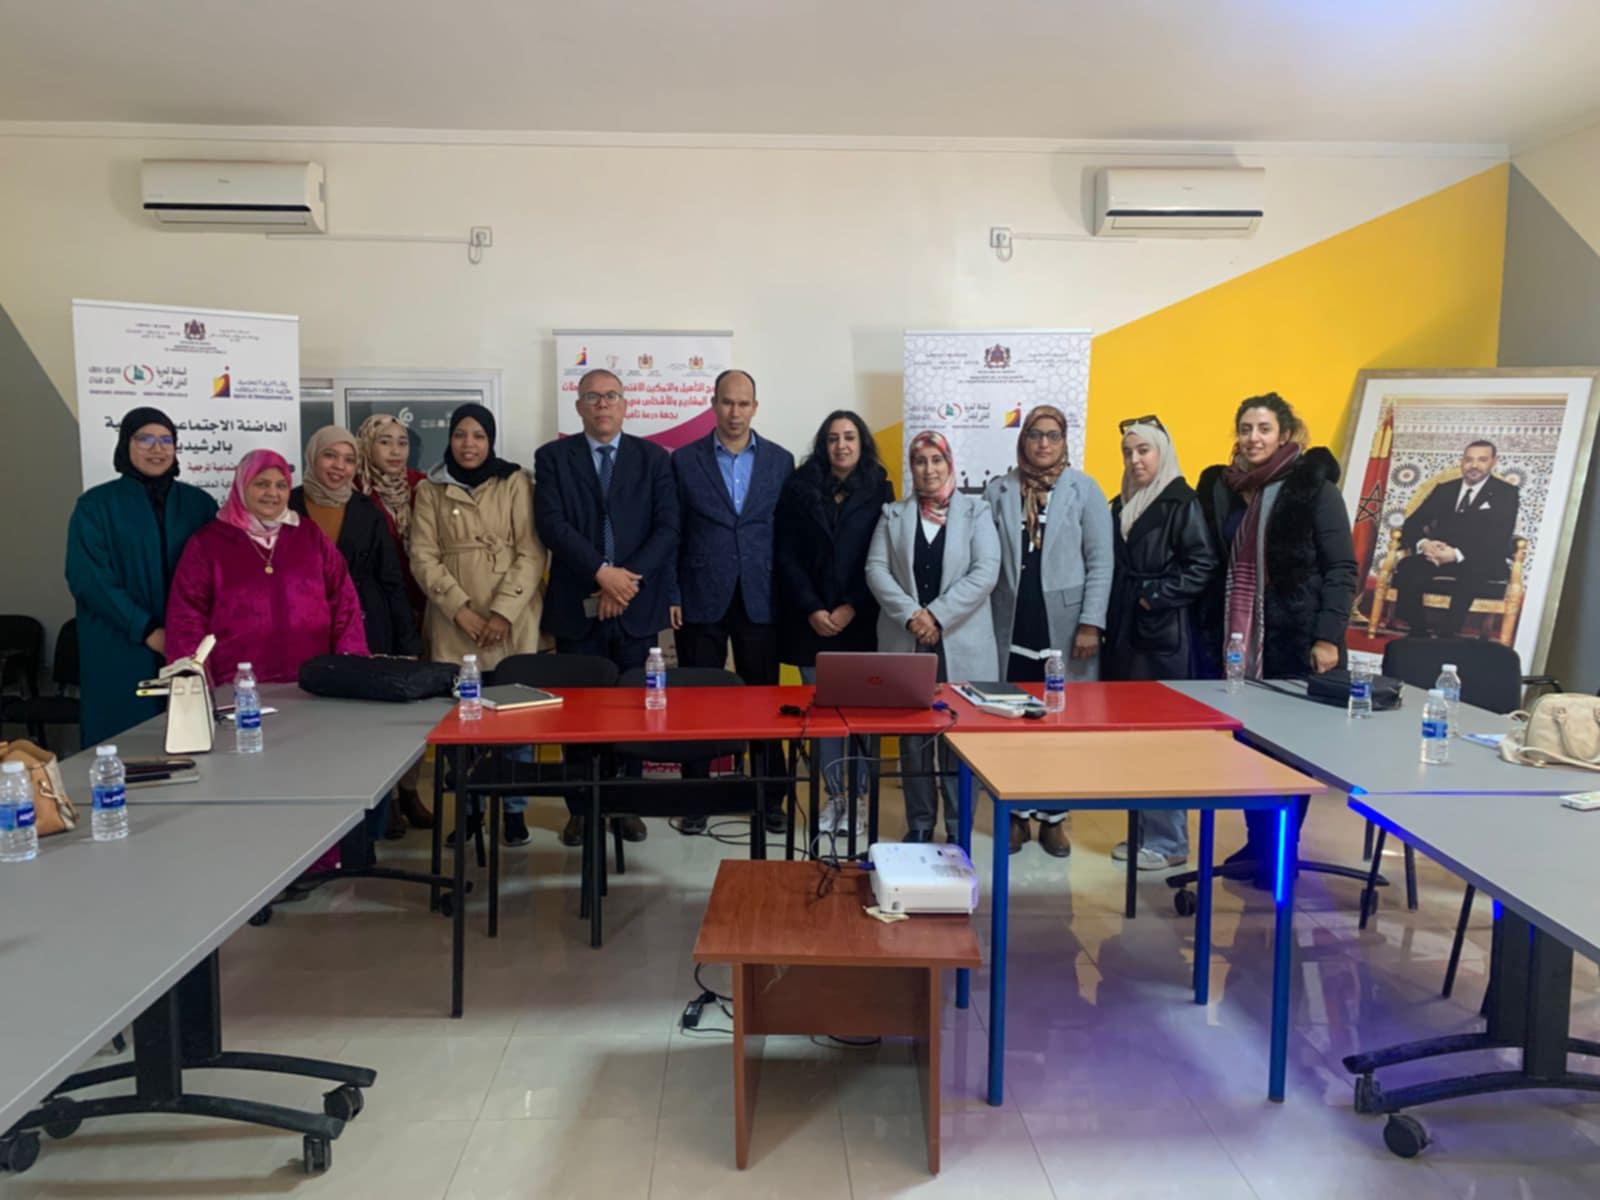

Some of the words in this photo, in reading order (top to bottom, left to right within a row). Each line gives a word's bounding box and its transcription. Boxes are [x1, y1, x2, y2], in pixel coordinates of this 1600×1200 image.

[175, 417, 234, 436] الاجتماع
[238, 418, 287, 433] الحاضنة
[175, 438, 233, 455] بالرشيدي
